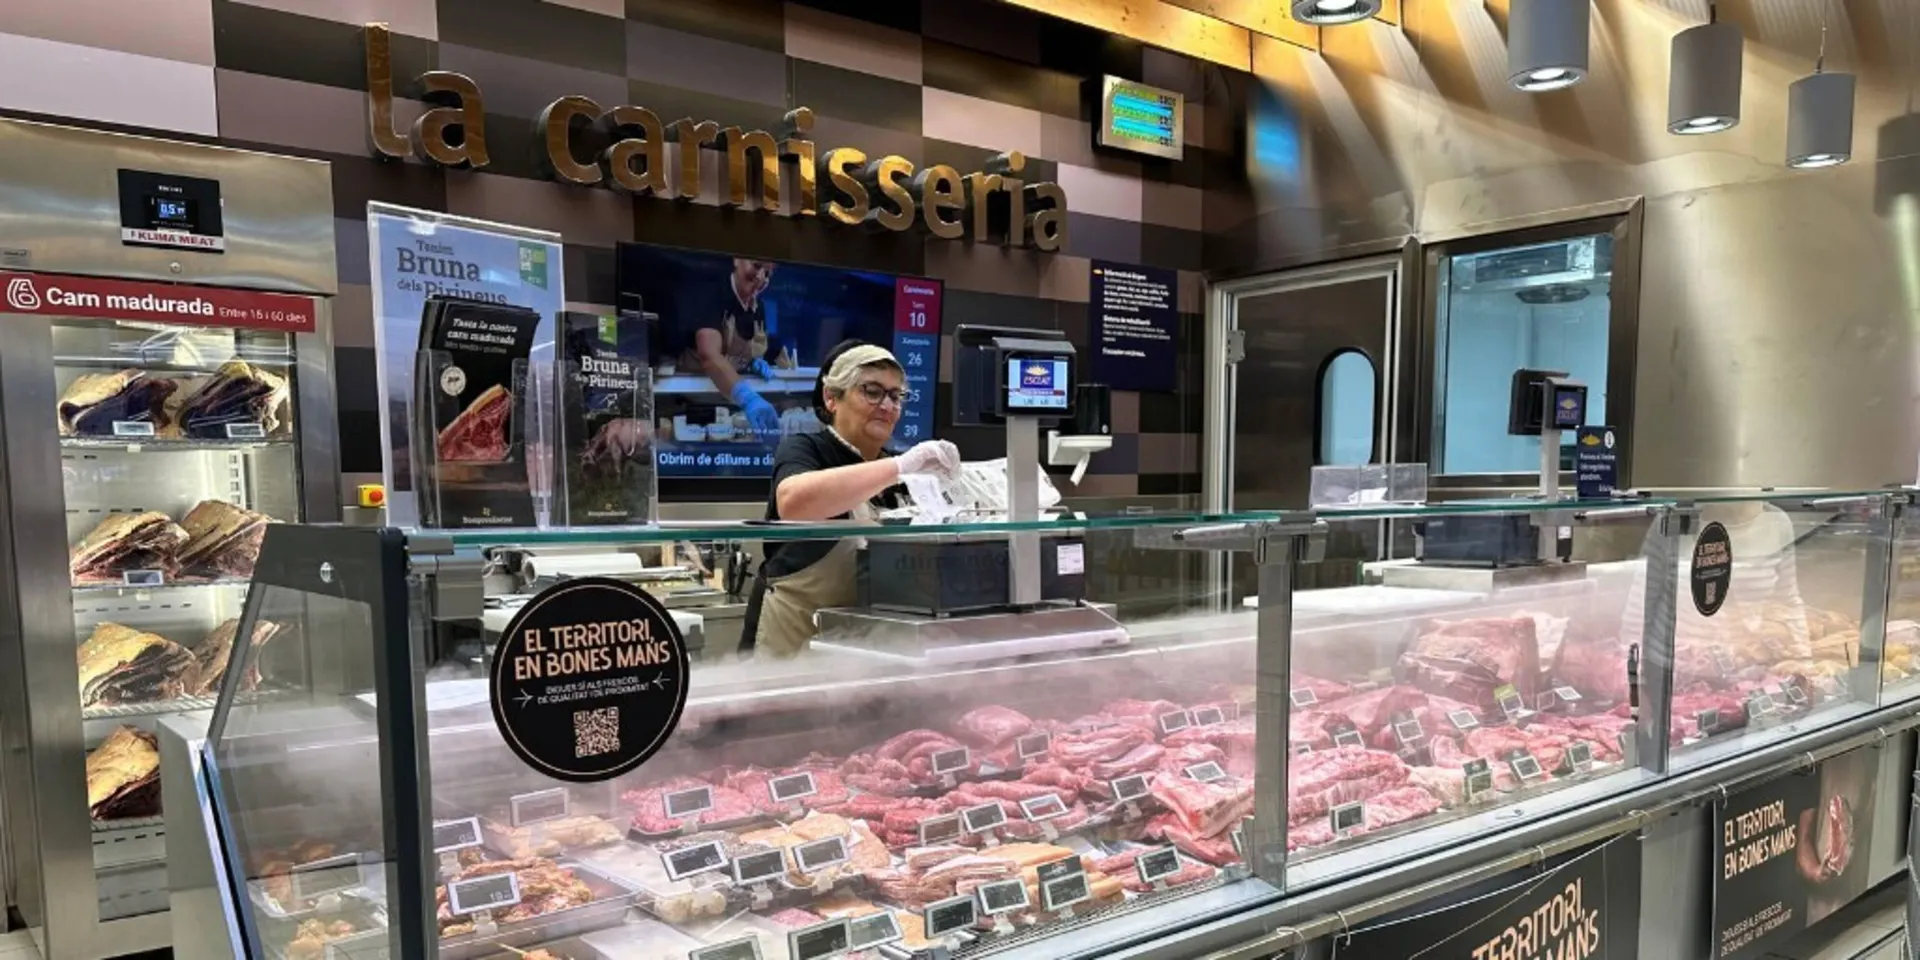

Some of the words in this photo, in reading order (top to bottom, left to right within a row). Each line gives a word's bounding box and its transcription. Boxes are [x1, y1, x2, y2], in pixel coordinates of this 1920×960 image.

[365, 22, 490, 168] la
[539, 95, 1068, 251] carnisseria
[138, 230, 176, 243] KLIMA
[179, 234, 215, 246] MEAT
[416, 240, 454, 255] Tenim
[396, 247, 481, 282] Bruna
[397, 278, 422, 292] dels
[46, 287, 100, 308] Carn
[106, 293, 215, 317] madurada
[286, 312, 307, 323] dies
[909, 312, 926, 328] 10
[581, 355, 631, 375] Bruna
[907, 352, 922, 366] 26
[590, 375, 638, 389] Pirineus
[904, 424, 919, 438] 39
[660, 452, 695, 465] Obrim
[697, 453, 712, 466] de
[714, 453, 751, 466] dilluns
[753, 456, 760, 466] a
[524, 628, 547, 653] EL
[551, 619, 655, 649] TERRITORI,
[515, 655, 542, 681] EN
[547, 648, 612, 676] BONES
[616, 640, 671, 669] MANS
[1724, 820, 1735, 847] EL
[1737, 799, 1786, 841] TERRITORI,
[1724, 853, 1738, 880] EN
[1739, 836, 1769, 874] BONES
[1770, 824, 1797, 858] MANS
